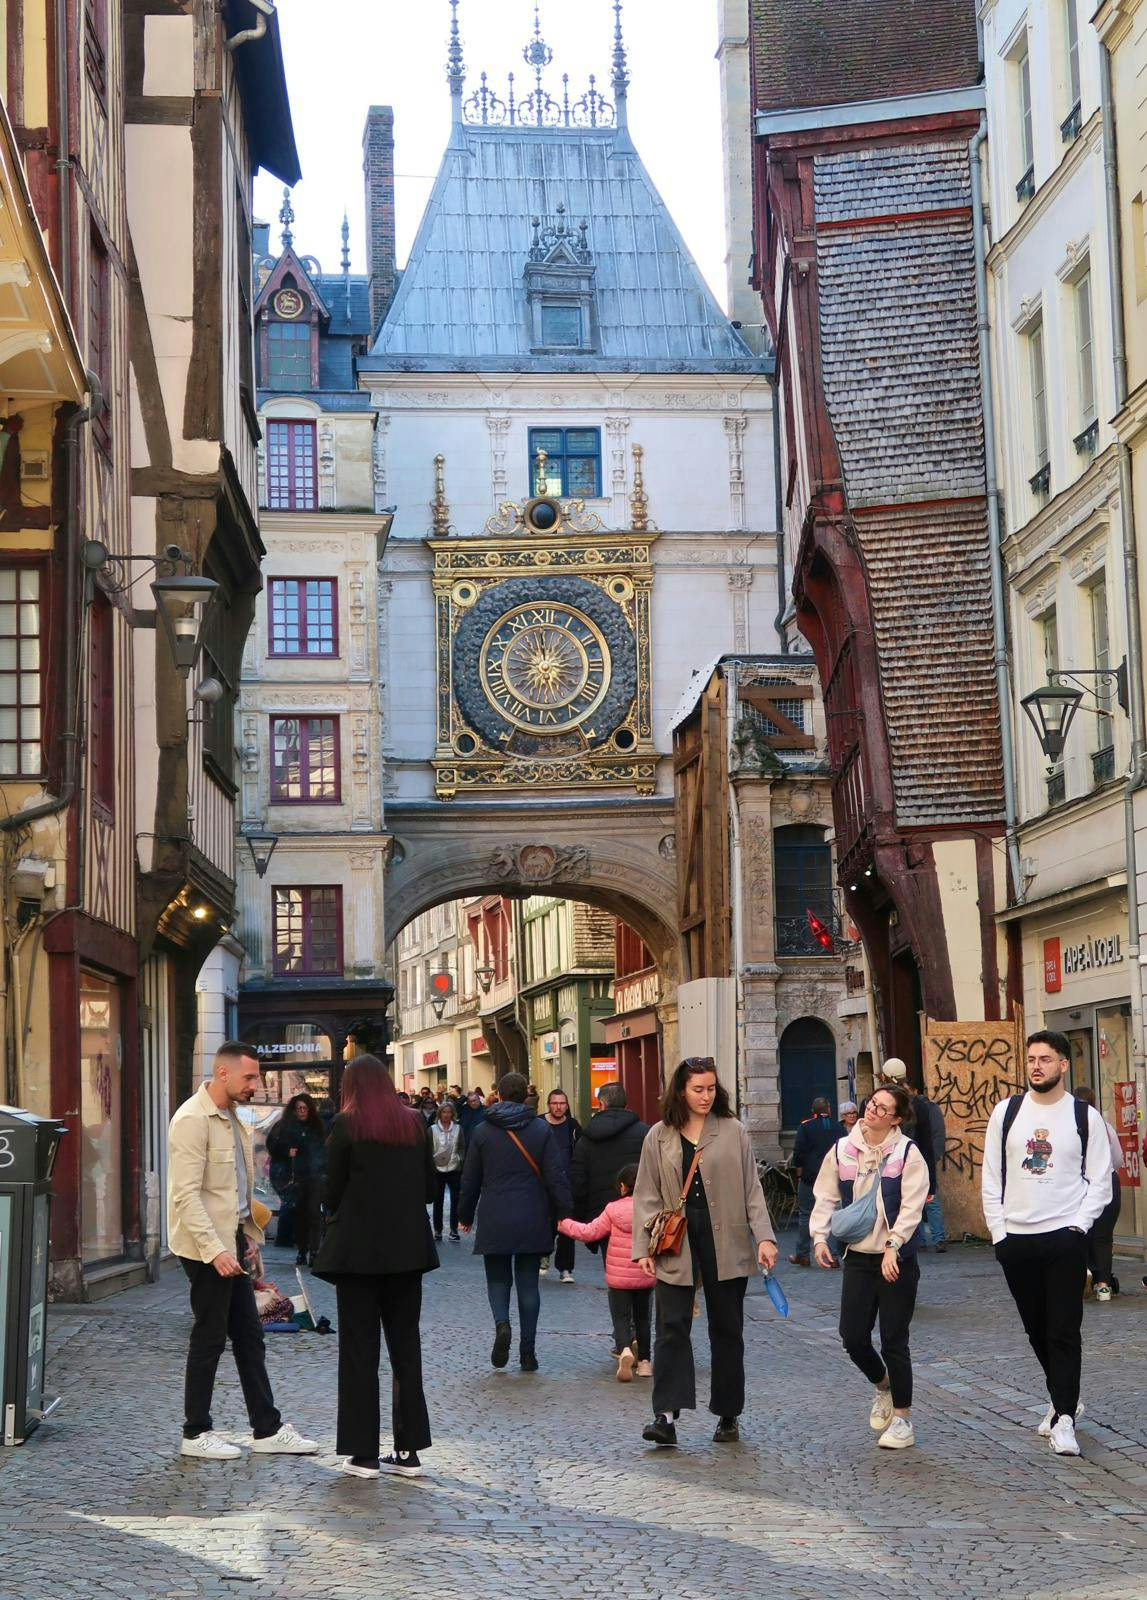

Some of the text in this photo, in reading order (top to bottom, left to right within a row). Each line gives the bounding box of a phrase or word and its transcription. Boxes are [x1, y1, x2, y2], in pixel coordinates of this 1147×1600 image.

[506, 613, 529, 634] XI
[531, 608, 555, 624] XII
[491, 634, 509, 652] X
[580, 633, 596, 647] II
[589, 658, 603, 672] III
[539, 710, 558, 724] VI
[567, 703, 581, 719] V
[1064, 943, 1086, 974] TAPE
[252, 1042, 324, 1055] ALZEDONIA
